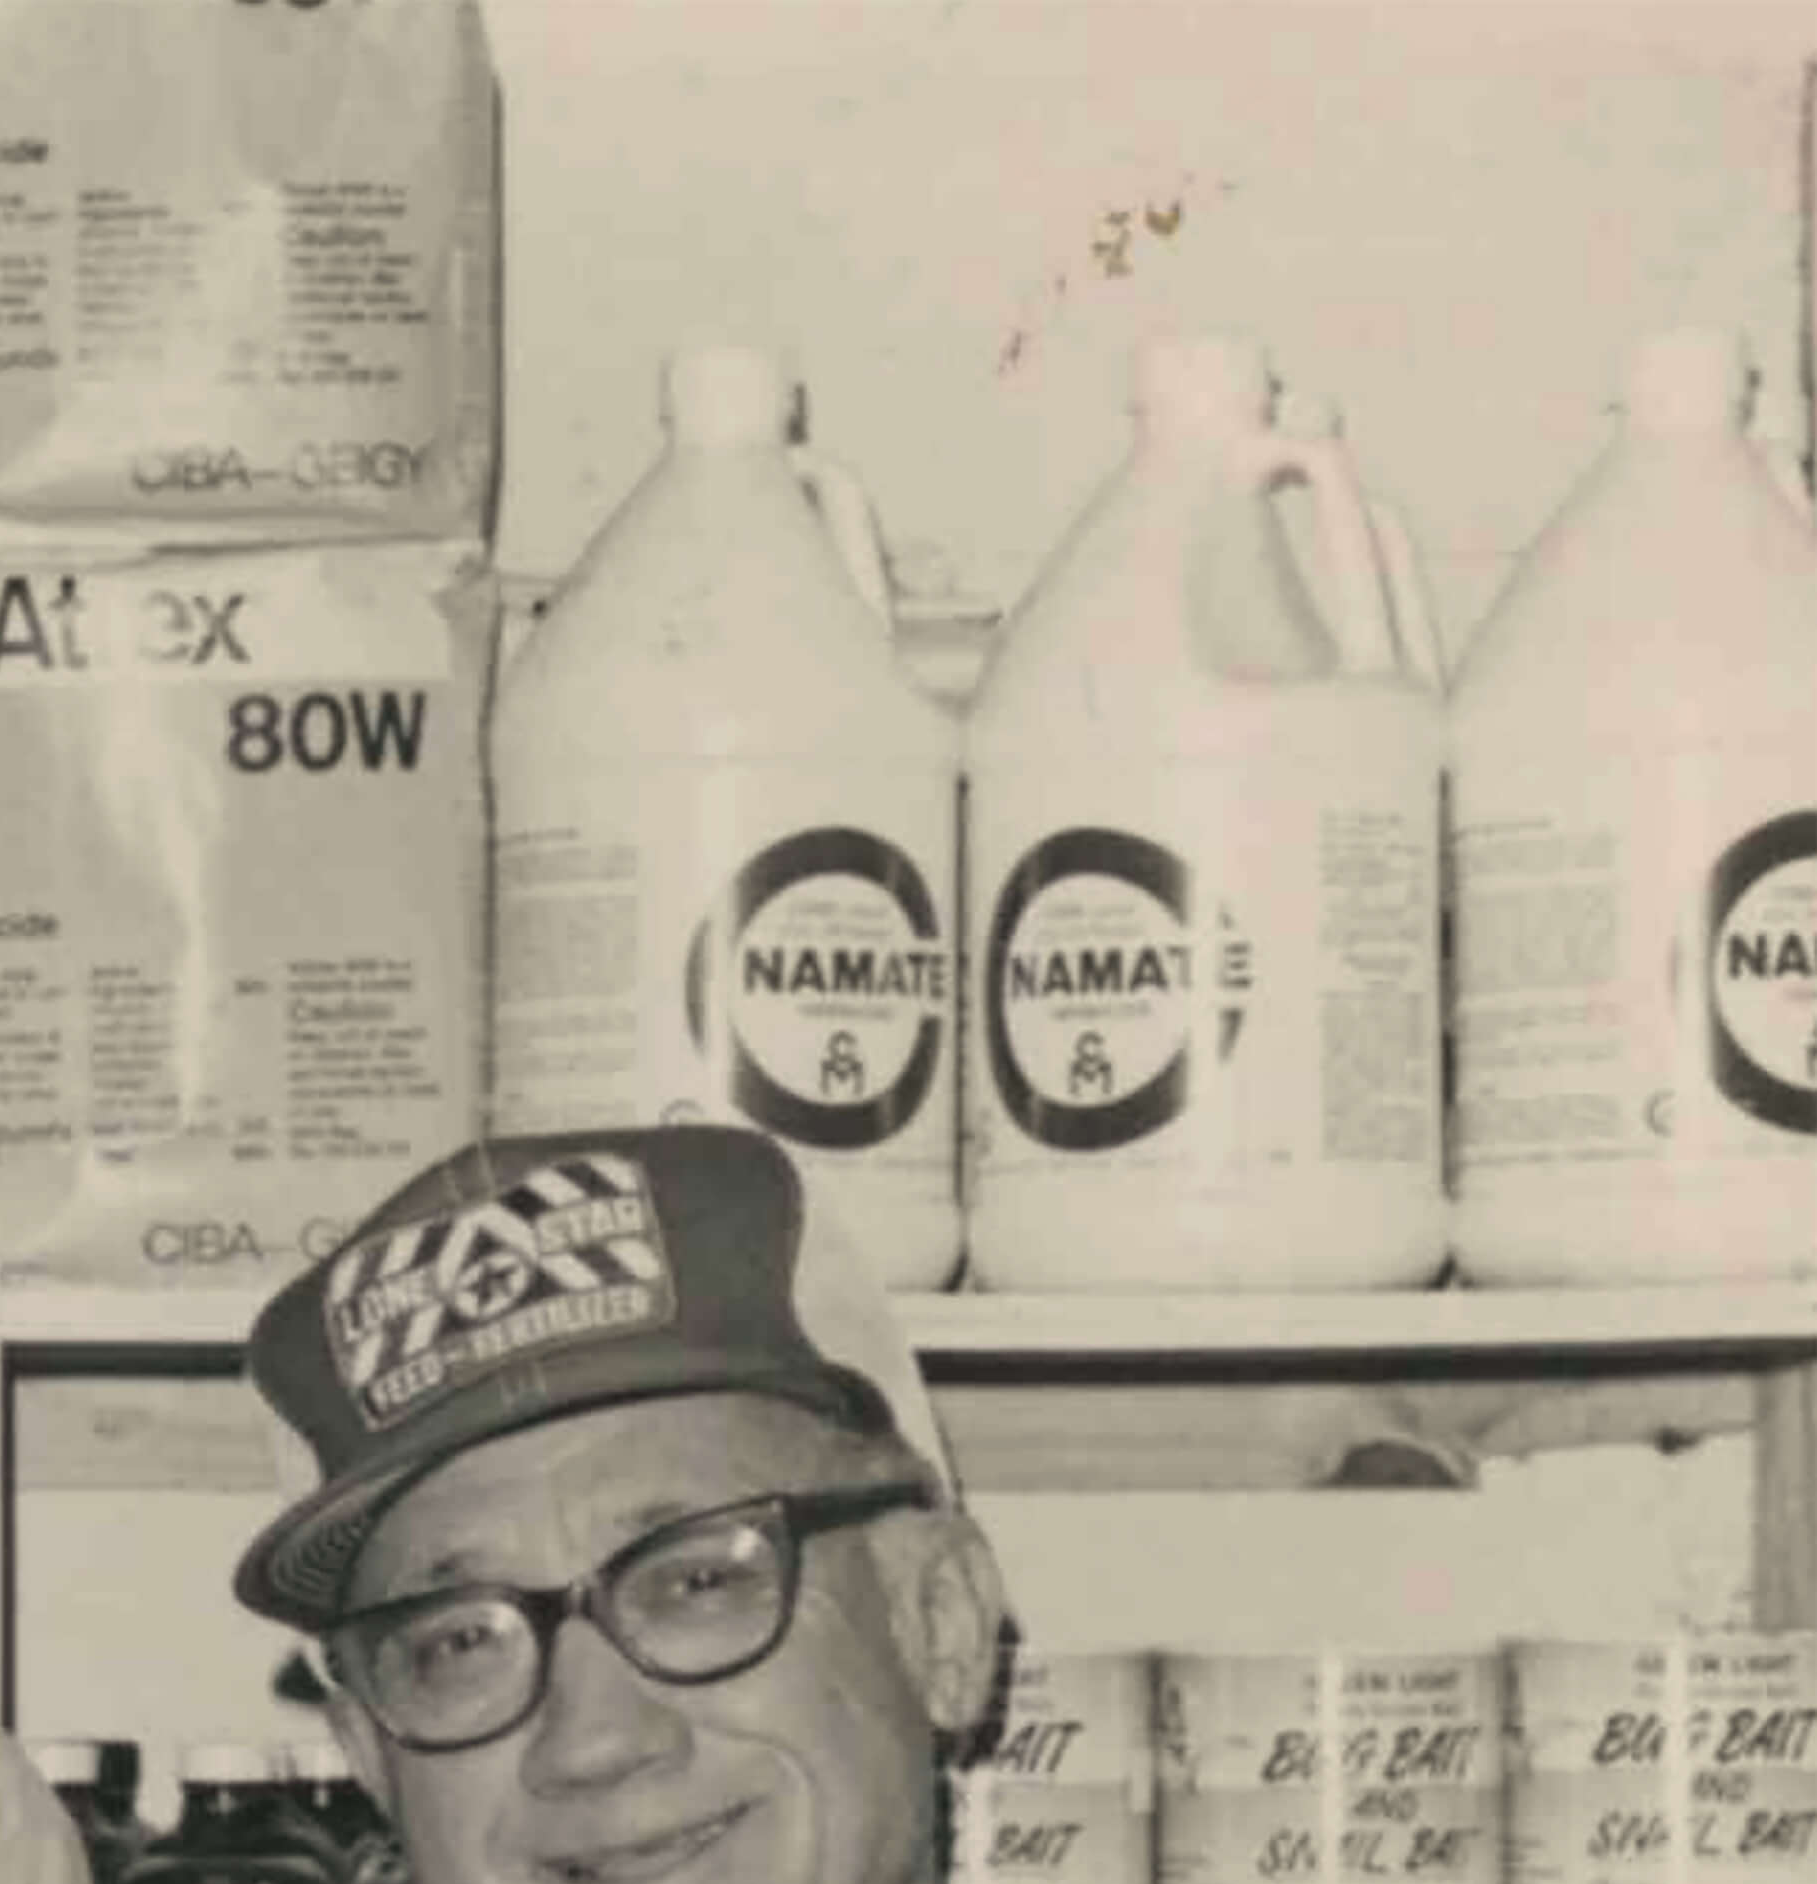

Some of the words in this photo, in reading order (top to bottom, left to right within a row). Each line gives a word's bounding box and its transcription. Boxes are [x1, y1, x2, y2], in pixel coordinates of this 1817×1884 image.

[225, 690, 427, 773] 80W
[743, 946, 950, 999] NAMATE
[1728, 928, 1817, 980] NA
[535, 1197, 644, 1256] STAR
[1383, 1723, 1485, 1782] BAIT
[988, 1822, 1087, 1870] BAIT
